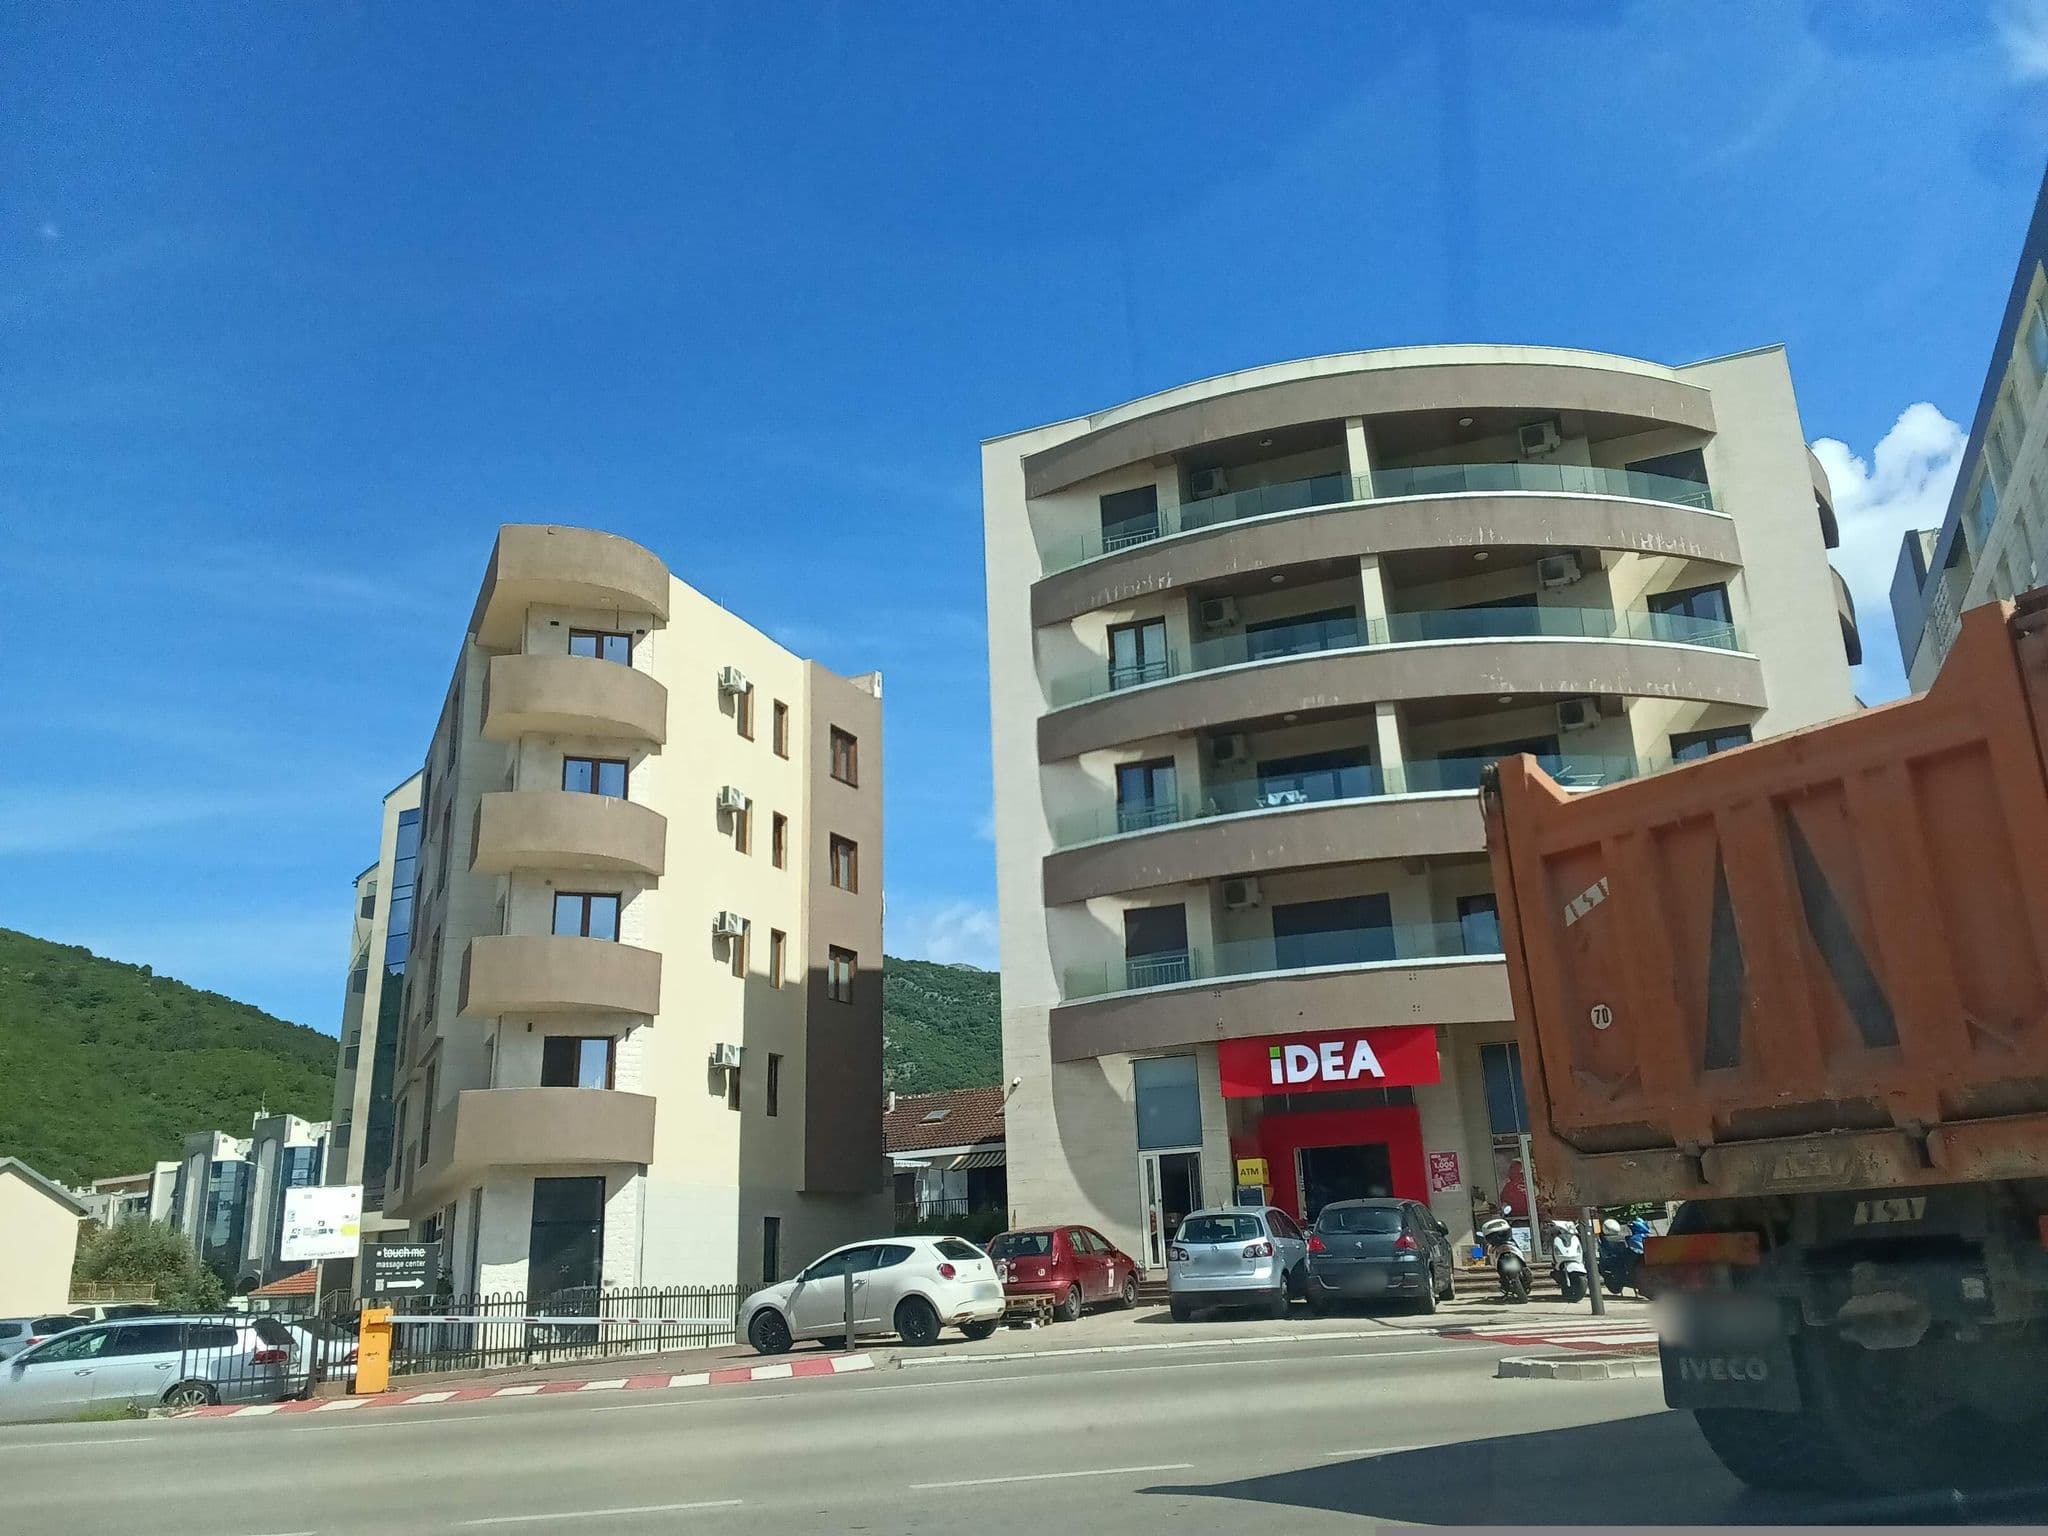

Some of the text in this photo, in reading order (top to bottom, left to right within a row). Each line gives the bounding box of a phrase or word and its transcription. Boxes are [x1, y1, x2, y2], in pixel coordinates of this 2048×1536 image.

[1594, 1008, 1609, 1024] 70
[1240, 1167, 1259, 1176] ATM
[375, 1261, 404, 1270] massage
[1680, 1357, 1768, 1381] IVECO
